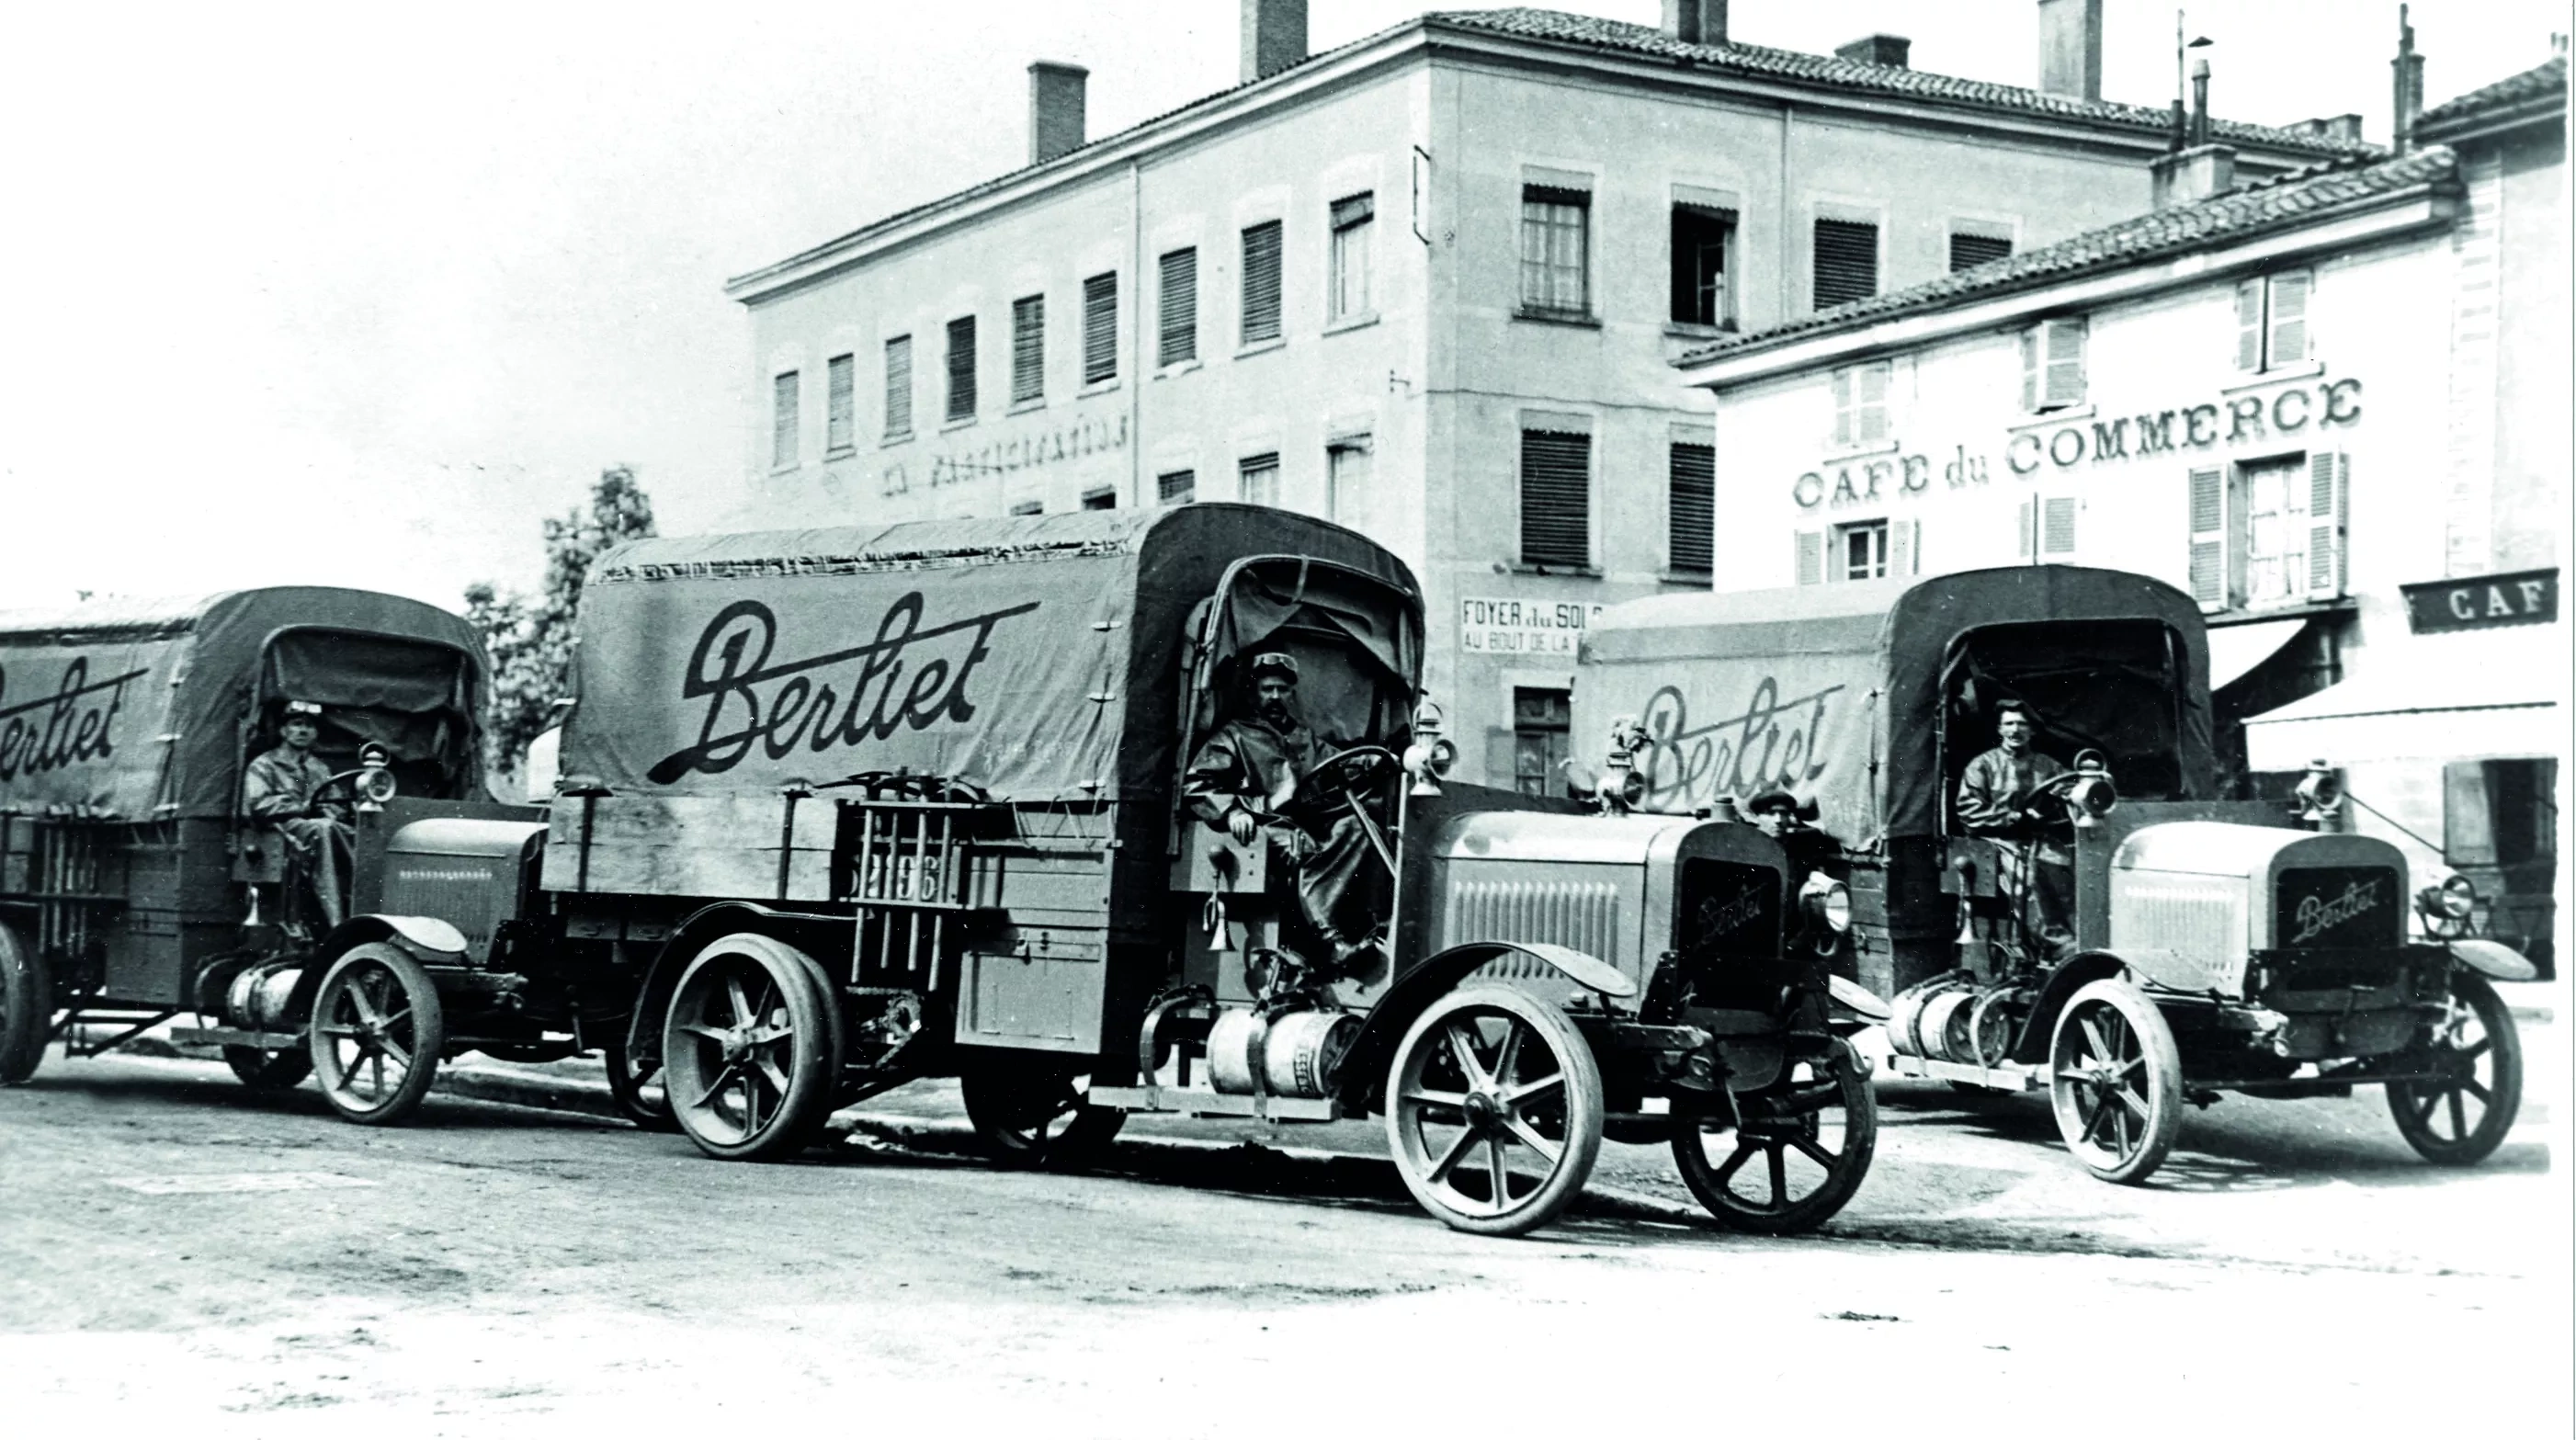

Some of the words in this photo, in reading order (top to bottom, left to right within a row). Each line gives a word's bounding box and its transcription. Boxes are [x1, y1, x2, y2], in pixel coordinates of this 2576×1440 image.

[1946, 445, 1991, 489] du
[2006, 378, 2363, 475] COMMERCE
[1463, 600, 1521, 627] FOYER
[1526, 607, 1552, 628] du
[1465, 632, 1482, 650] AU
[1489, 631, 1524, 651] BOUT
[1530, 633, 1547, 652] DE
[2449, 581, 2545, 619] CAF
[0, 656, 151, 781] erliet
[646, 591, 1041, 785] Berliet
[1642, 676, 1845, 811] Berliet
[2292, 879, 2383, 944] Berliet
